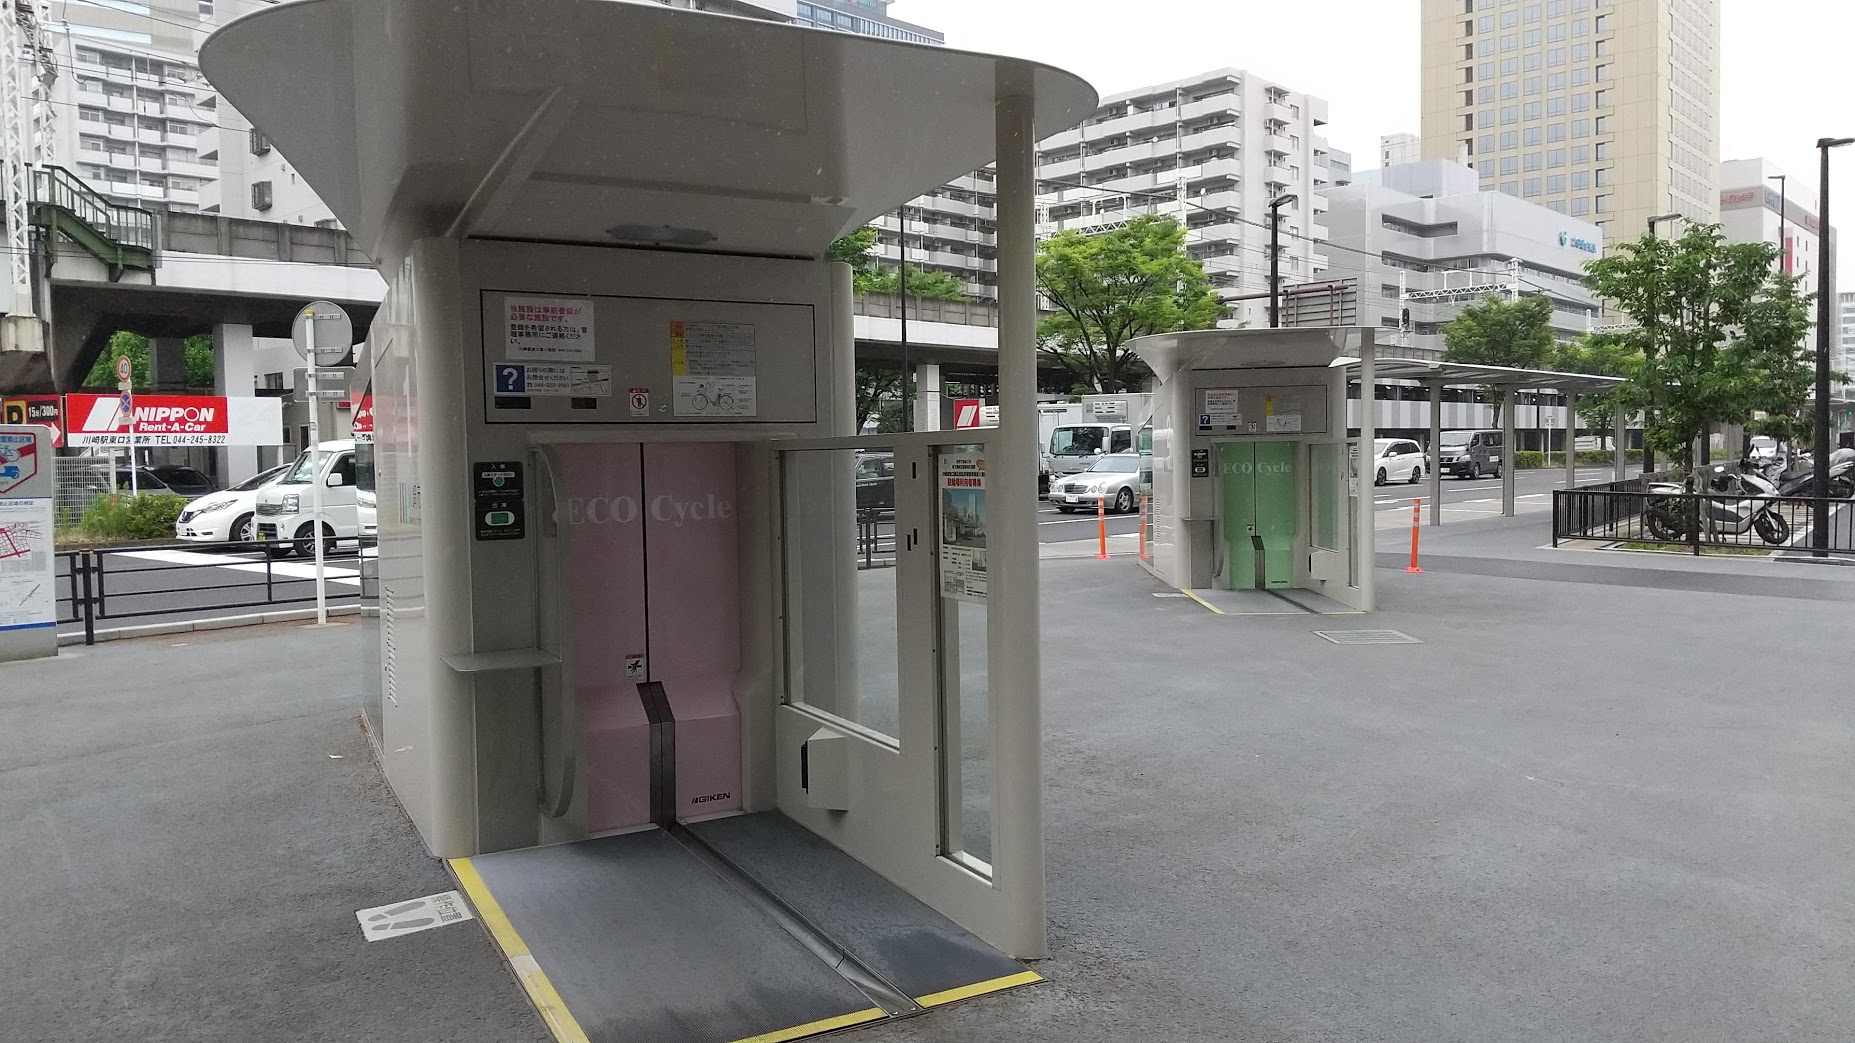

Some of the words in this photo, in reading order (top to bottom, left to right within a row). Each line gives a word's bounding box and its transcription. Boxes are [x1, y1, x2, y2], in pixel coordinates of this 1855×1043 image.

[136, 407, 215, 422] NIPPON
[140, 422, 207, 432] Rent-A-Car
[157, 435, 173, 445] TEL
[173, 435, 227, 444] 044-245-8322
[1223, 461, 1253, 474] ECO
[1257, 461, 1292, 476] Cycle
[568, 496, 638, 525] ECO
[651, 493, 733, 527] Cycle
[698, 792, 731, 804] GIKEN
